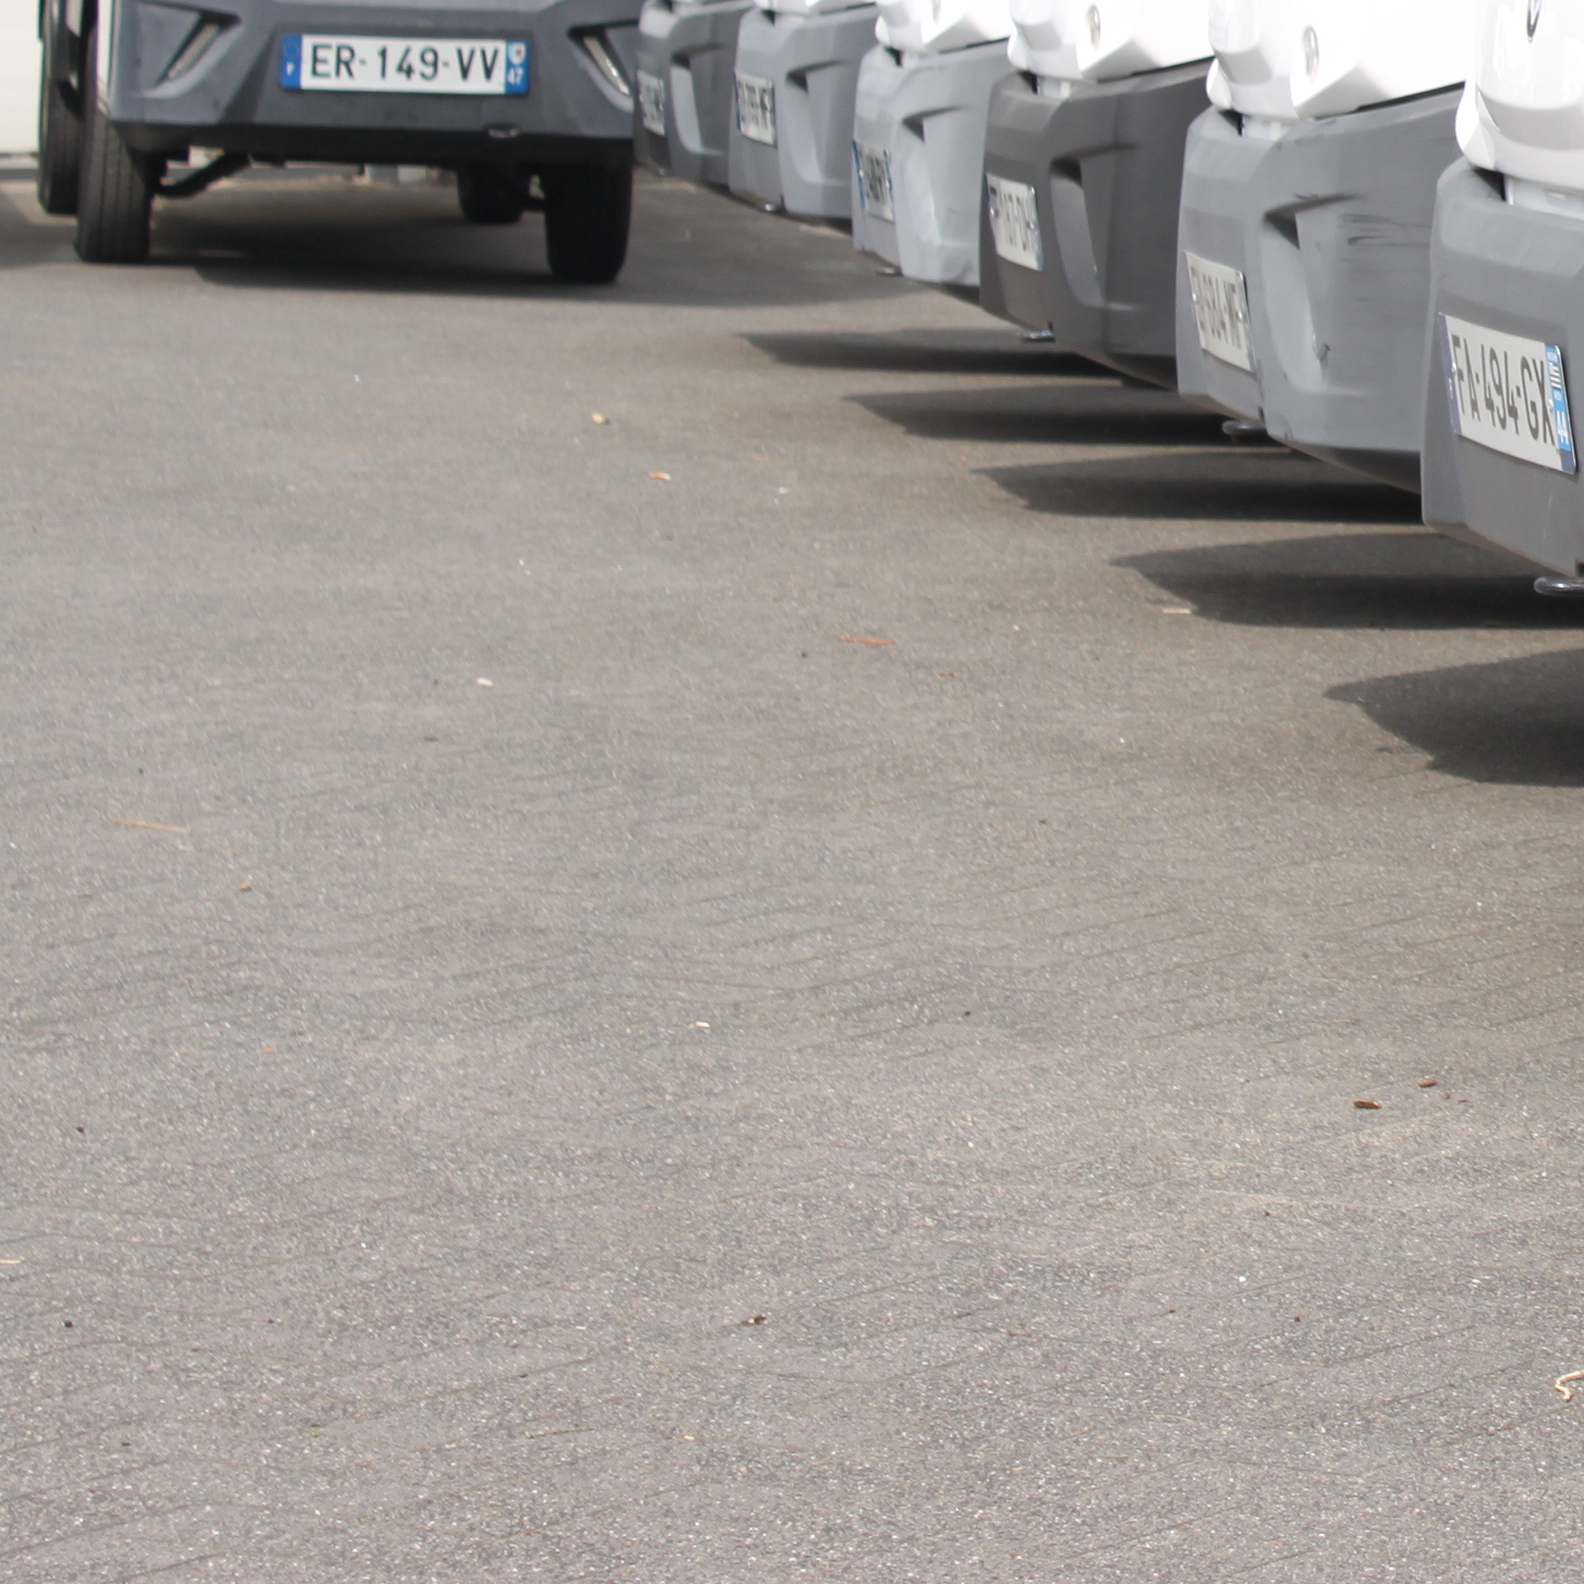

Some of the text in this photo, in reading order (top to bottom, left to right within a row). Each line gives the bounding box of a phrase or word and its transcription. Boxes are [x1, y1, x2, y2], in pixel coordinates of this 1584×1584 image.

[310, 43, 499, 82] ER-149-VV
[506, 67, 524, 86] 47
[1451, 334, 1556, 447] FA-494-GX
